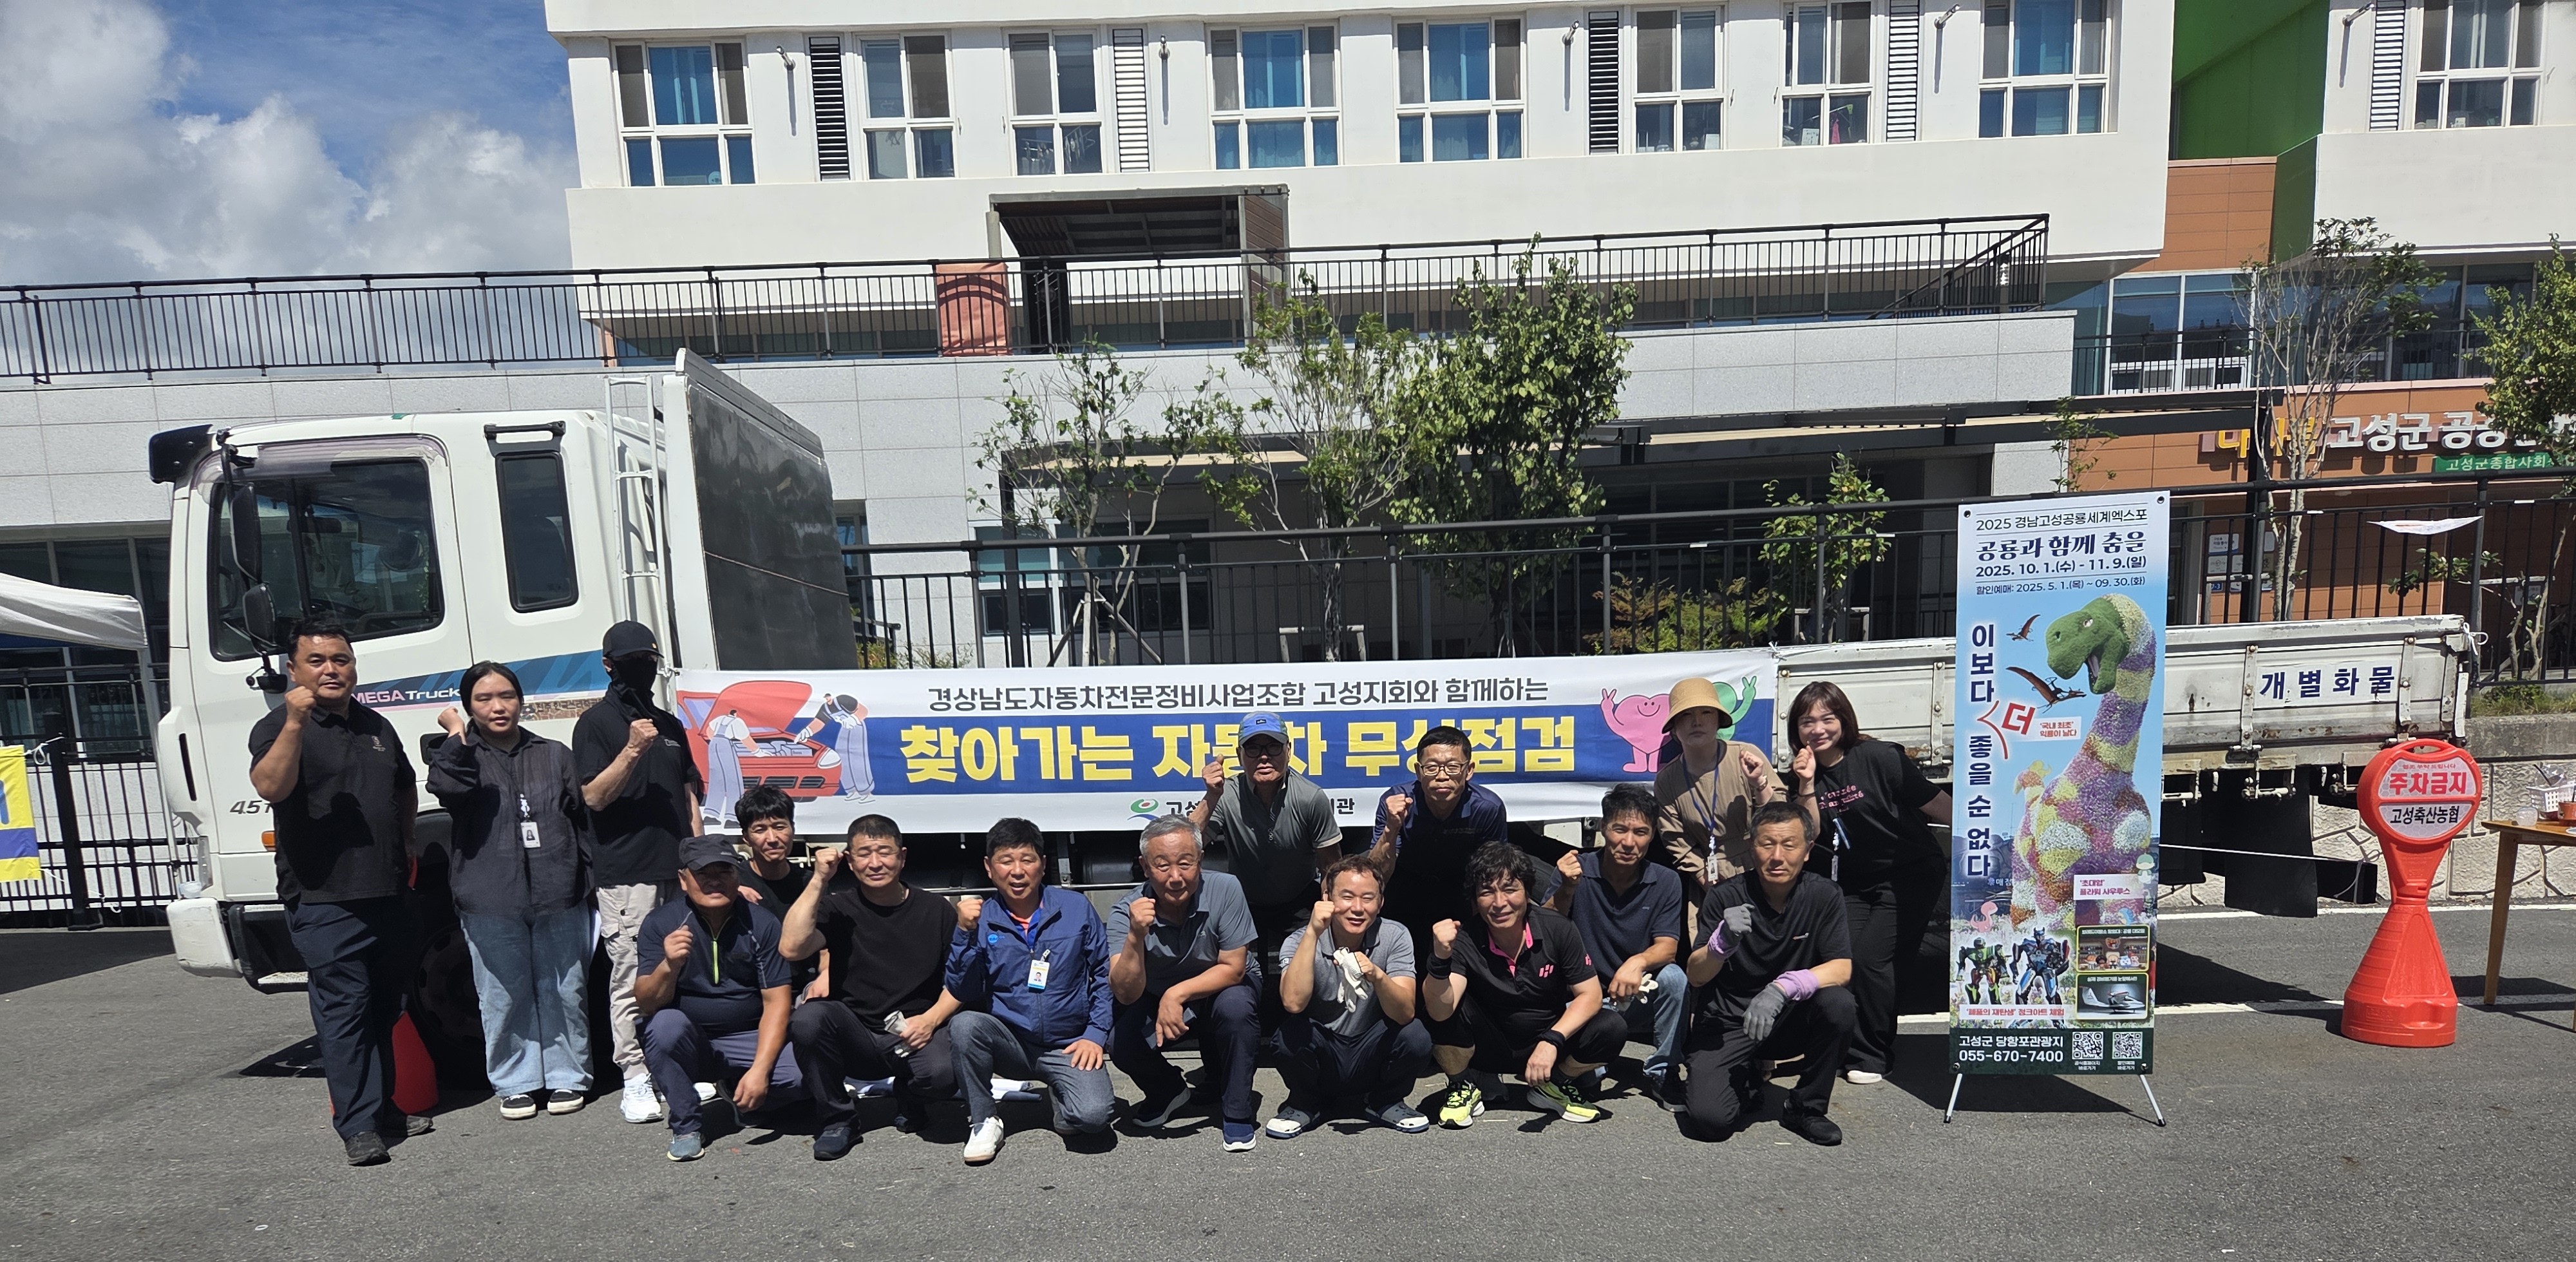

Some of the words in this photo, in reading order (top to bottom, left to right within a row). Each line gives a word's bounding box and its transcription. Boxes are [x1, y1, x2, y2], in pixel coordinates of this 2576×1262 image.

[2326, 413, 2432, 452] 고성군
[2446, 454, 2575, 471] 고성군종합사회
[1976, 519, 2012, 531] 2025
[2015, 509, 2148, 528] 경남고성공룡세계엑스포
[1976, 537, 2044, 561] 공룡과
[2049, 534, 2095, 557] 함께
[2101, 531, 2146, 553] 춤을
[1976, 565, 2014, 577] 2025.
[2019, 563, 2039, 575] 10.
[2044, 560, 2076, 573] 1.(수)
[2089, 559, 2109, 571] 11.
[2113, 556, 2146, 569] 9.(일)
[1976, 584, 2014, 595] 할인예매:
[2016, 582, 2045, 592] 2025.
[1971, 624, 1994, 703] 이보다
[929, 682, 1306, 712] 경상남도자동차전문정비사업조합
[1313, 680, 1439, 705] 고성지회와
[1446, 677, 1548, 703] 함께하는
[2259, 666, 2395, 700] 개별화물
[351, 690, 406, 703] MEGA
[405, 688, 460, 700] Truck
[2002, 702, 2036, 735] 더
[900, 725, 1133, 783] 찾아가는
[1968, 735, 1993, 786] 좋을
[2389, 772, 2467, 795] 주차금지
[1967, 794, 1991, 818] 순
[2390, 806, 2459, 825] 고성축산농협
[1967, 827, 1992, 877] 없다
[1959, 1036, 1993, 1047] 고성군
[1996, 1036, 2063, 1047] 당항포관광지
[1959, 1050, 2063, 1062] 055-670-7400
